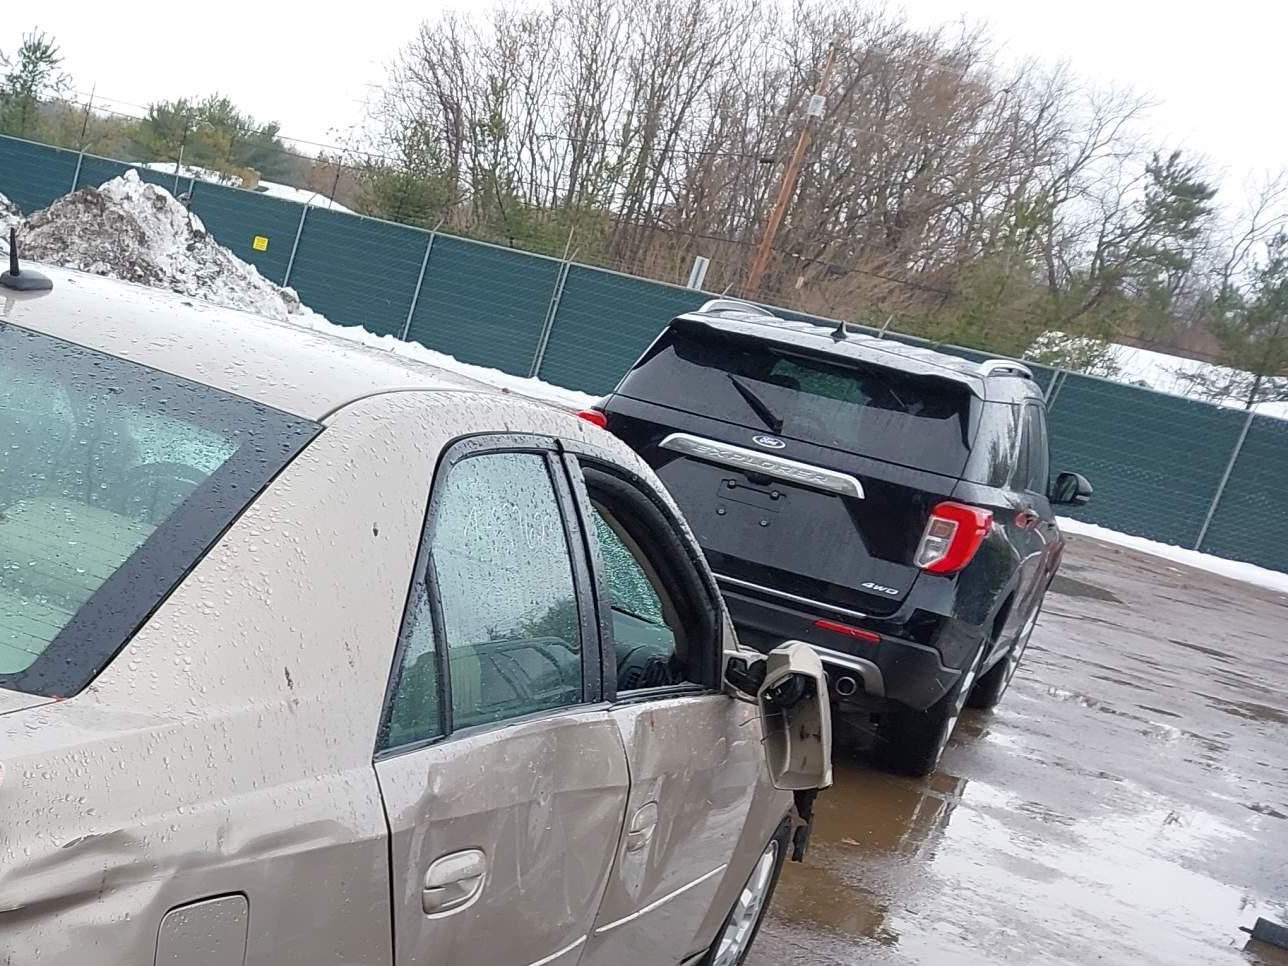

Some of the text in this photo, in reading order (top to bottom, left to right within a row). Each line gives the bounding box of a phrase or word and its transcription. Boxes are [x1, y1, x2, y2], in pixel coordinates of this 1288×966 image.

[756, 435, 781, 447] Ford
[692, 444, 829, 484] EXPLORER
[861, 582, 899, 595] 4WD
